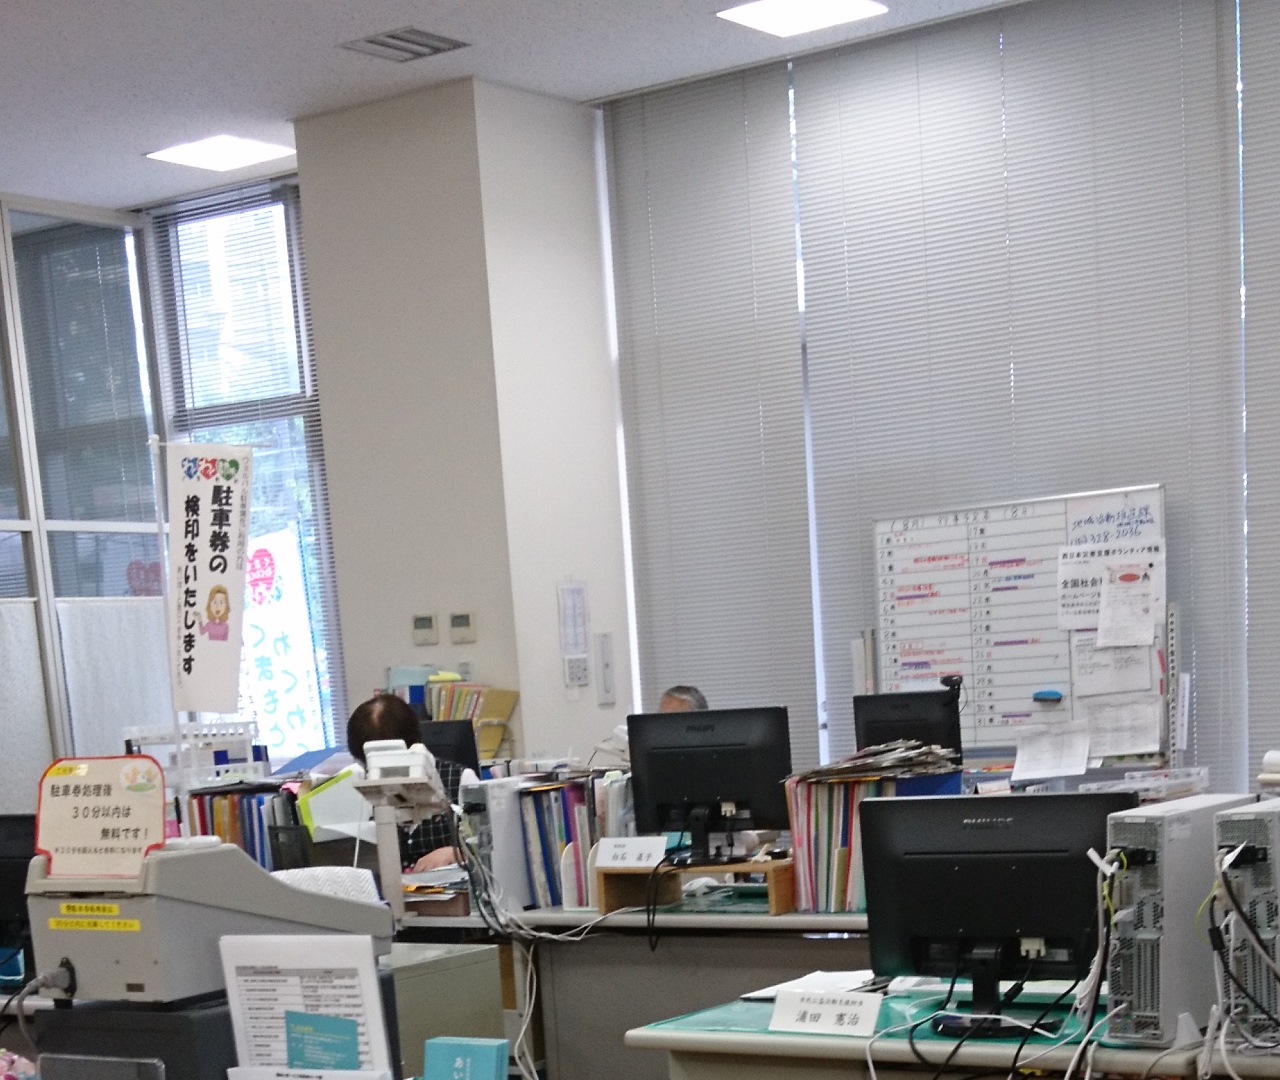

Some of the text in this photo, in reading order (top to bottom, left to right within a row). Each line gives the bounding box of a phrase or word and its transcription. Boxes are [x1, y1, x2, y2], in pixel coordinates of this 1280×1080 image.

[208, 485, 234, 574] 駐車券の
[182, 495, 201, 676] 検印をいたします
[1061, 577, 1102, 589] 全国社会
[50, 784, 114, 798] 駐車券処理後
